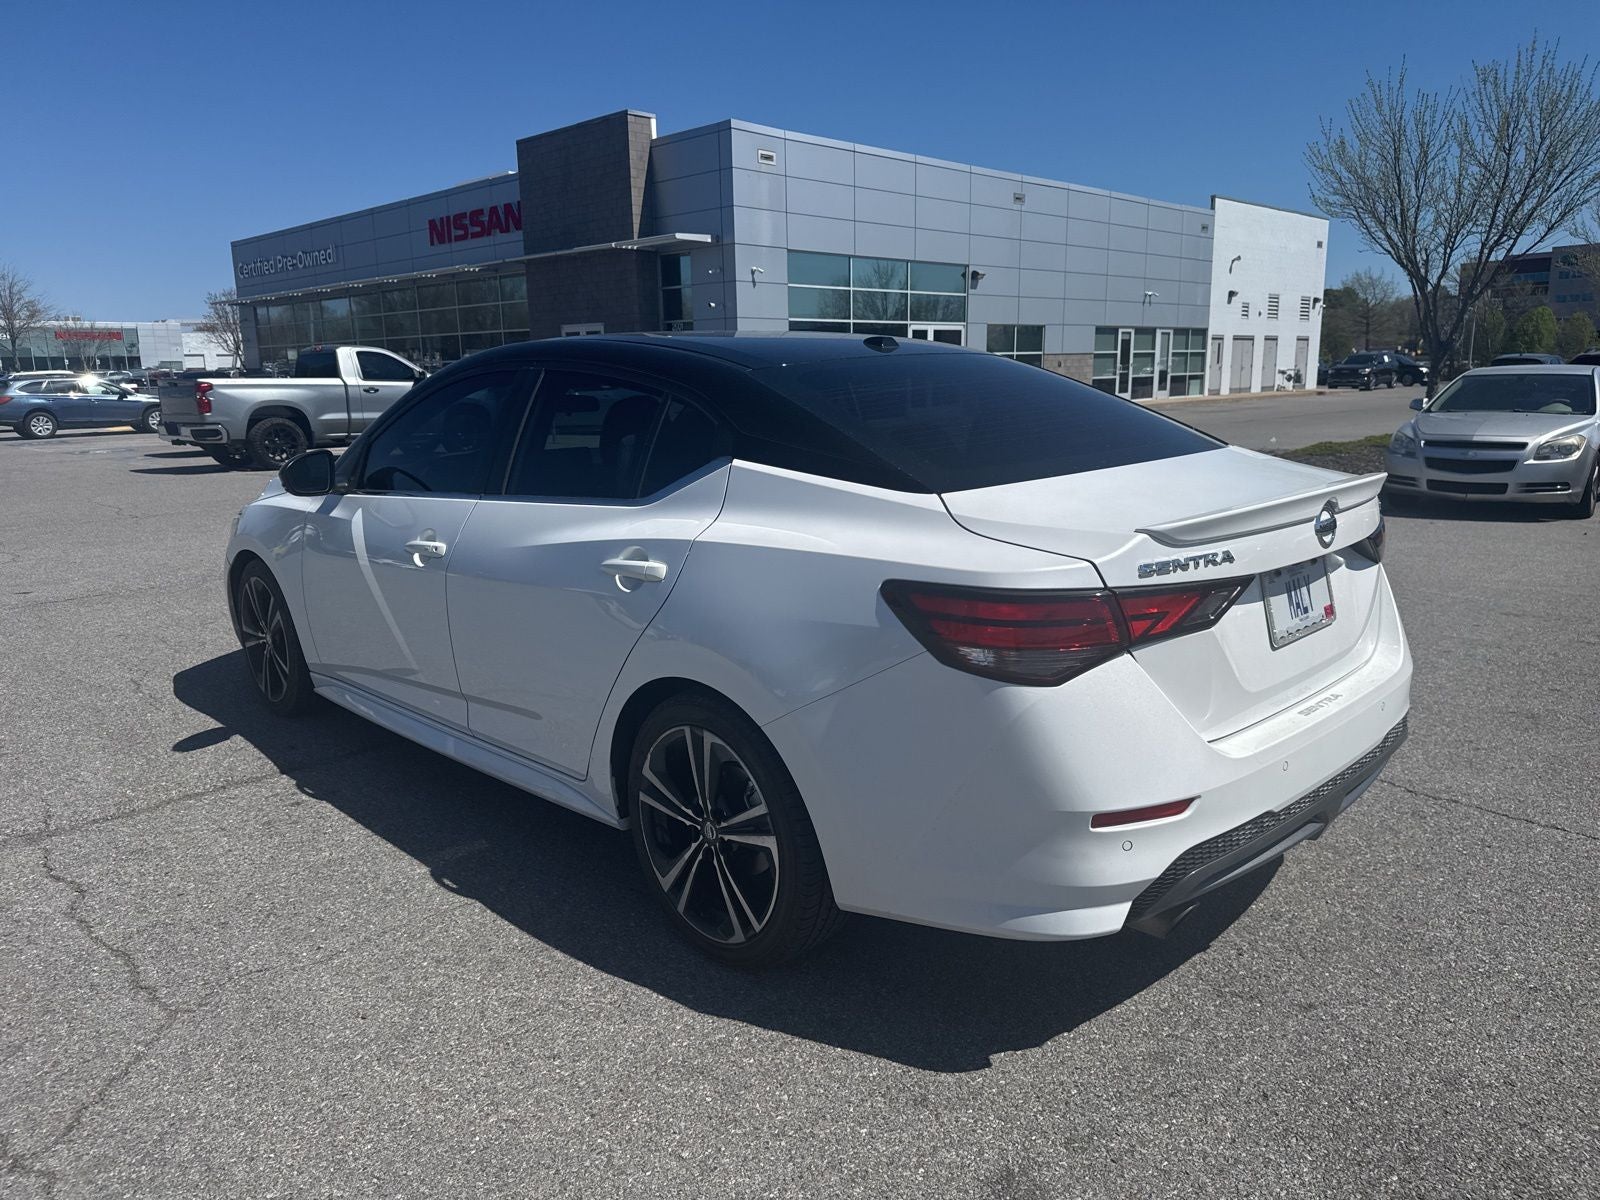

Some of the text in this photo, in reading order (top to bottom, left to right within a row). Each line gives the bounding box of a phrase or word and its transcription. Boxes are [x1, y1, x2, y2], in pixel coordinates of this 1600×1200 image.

[428, 201, 522, 246] NISSAN
[238, 242, 335, 279] Certified Pre-Owned
[1137, 550, 1235, 579] SENTRA
[1297, 694, 1343, 717] SENTRA
